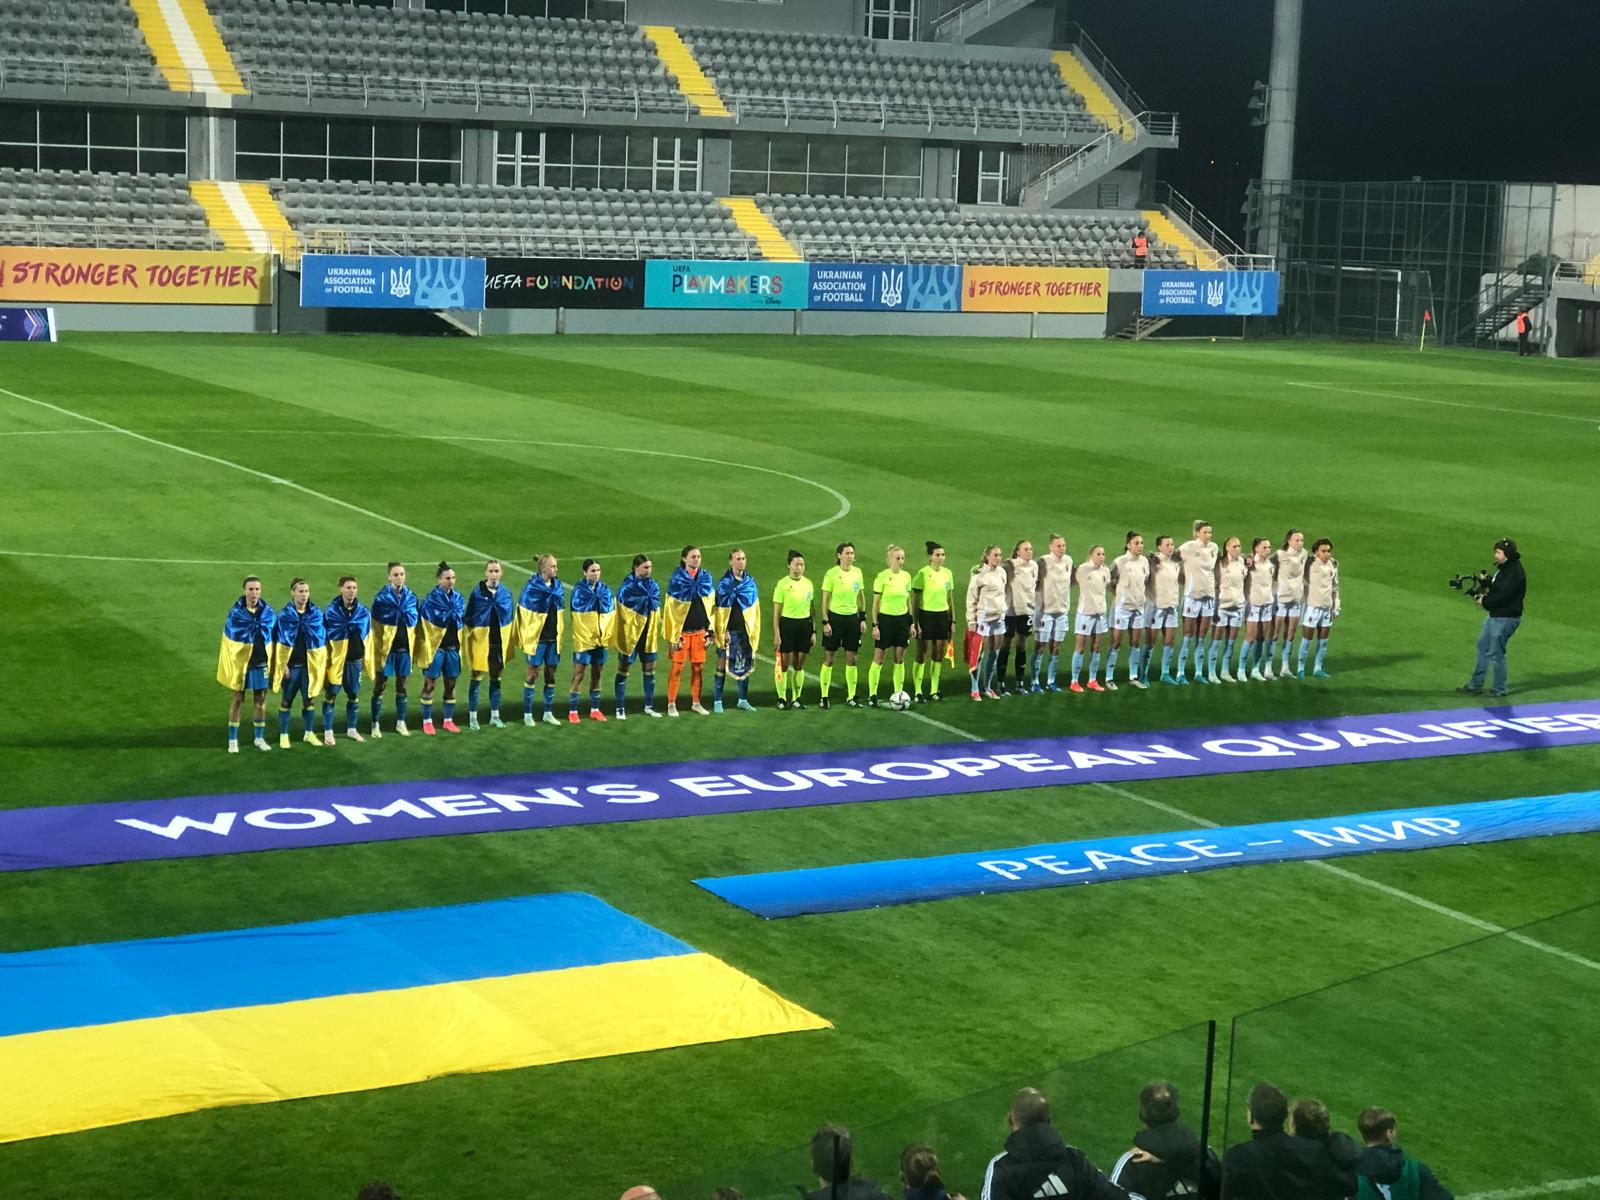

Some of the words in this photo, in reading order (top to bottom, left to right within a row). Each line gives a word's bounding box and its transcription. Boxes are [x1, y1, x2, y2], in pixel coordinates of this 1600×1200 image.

[327, 267, 372, 276] UKRAINIAN
[672, 265, 691, 273] UEFA
[12, 261, 139, 288] STRONGER
[146, 264, 258, 289] TOGETHER
[817, 270, 864, 280] UKRAINIAN
[323, 276, 376, 285] ASSOCIATION
[484, 273, 523, 290] UEFA
[525, 275, 635, 291] FOUNDATION
[672, 274, 783, 295] PLAYMAKERS
[333, 285, 374, 294] FOOTBALL
[812, 281, 867, 291] ASSOCIATION
[979, 280, 1041, 297] STRONGER
[1045, 281, 1102, 298] TOGETHER
[822, 292, 864, 302] FOOTBALL
[1165, 296, 1195, 304] FOOTBALL
[669, 744, 1200, 798] EUROPEAN
[977, 839, 1243, 880] PEACE
